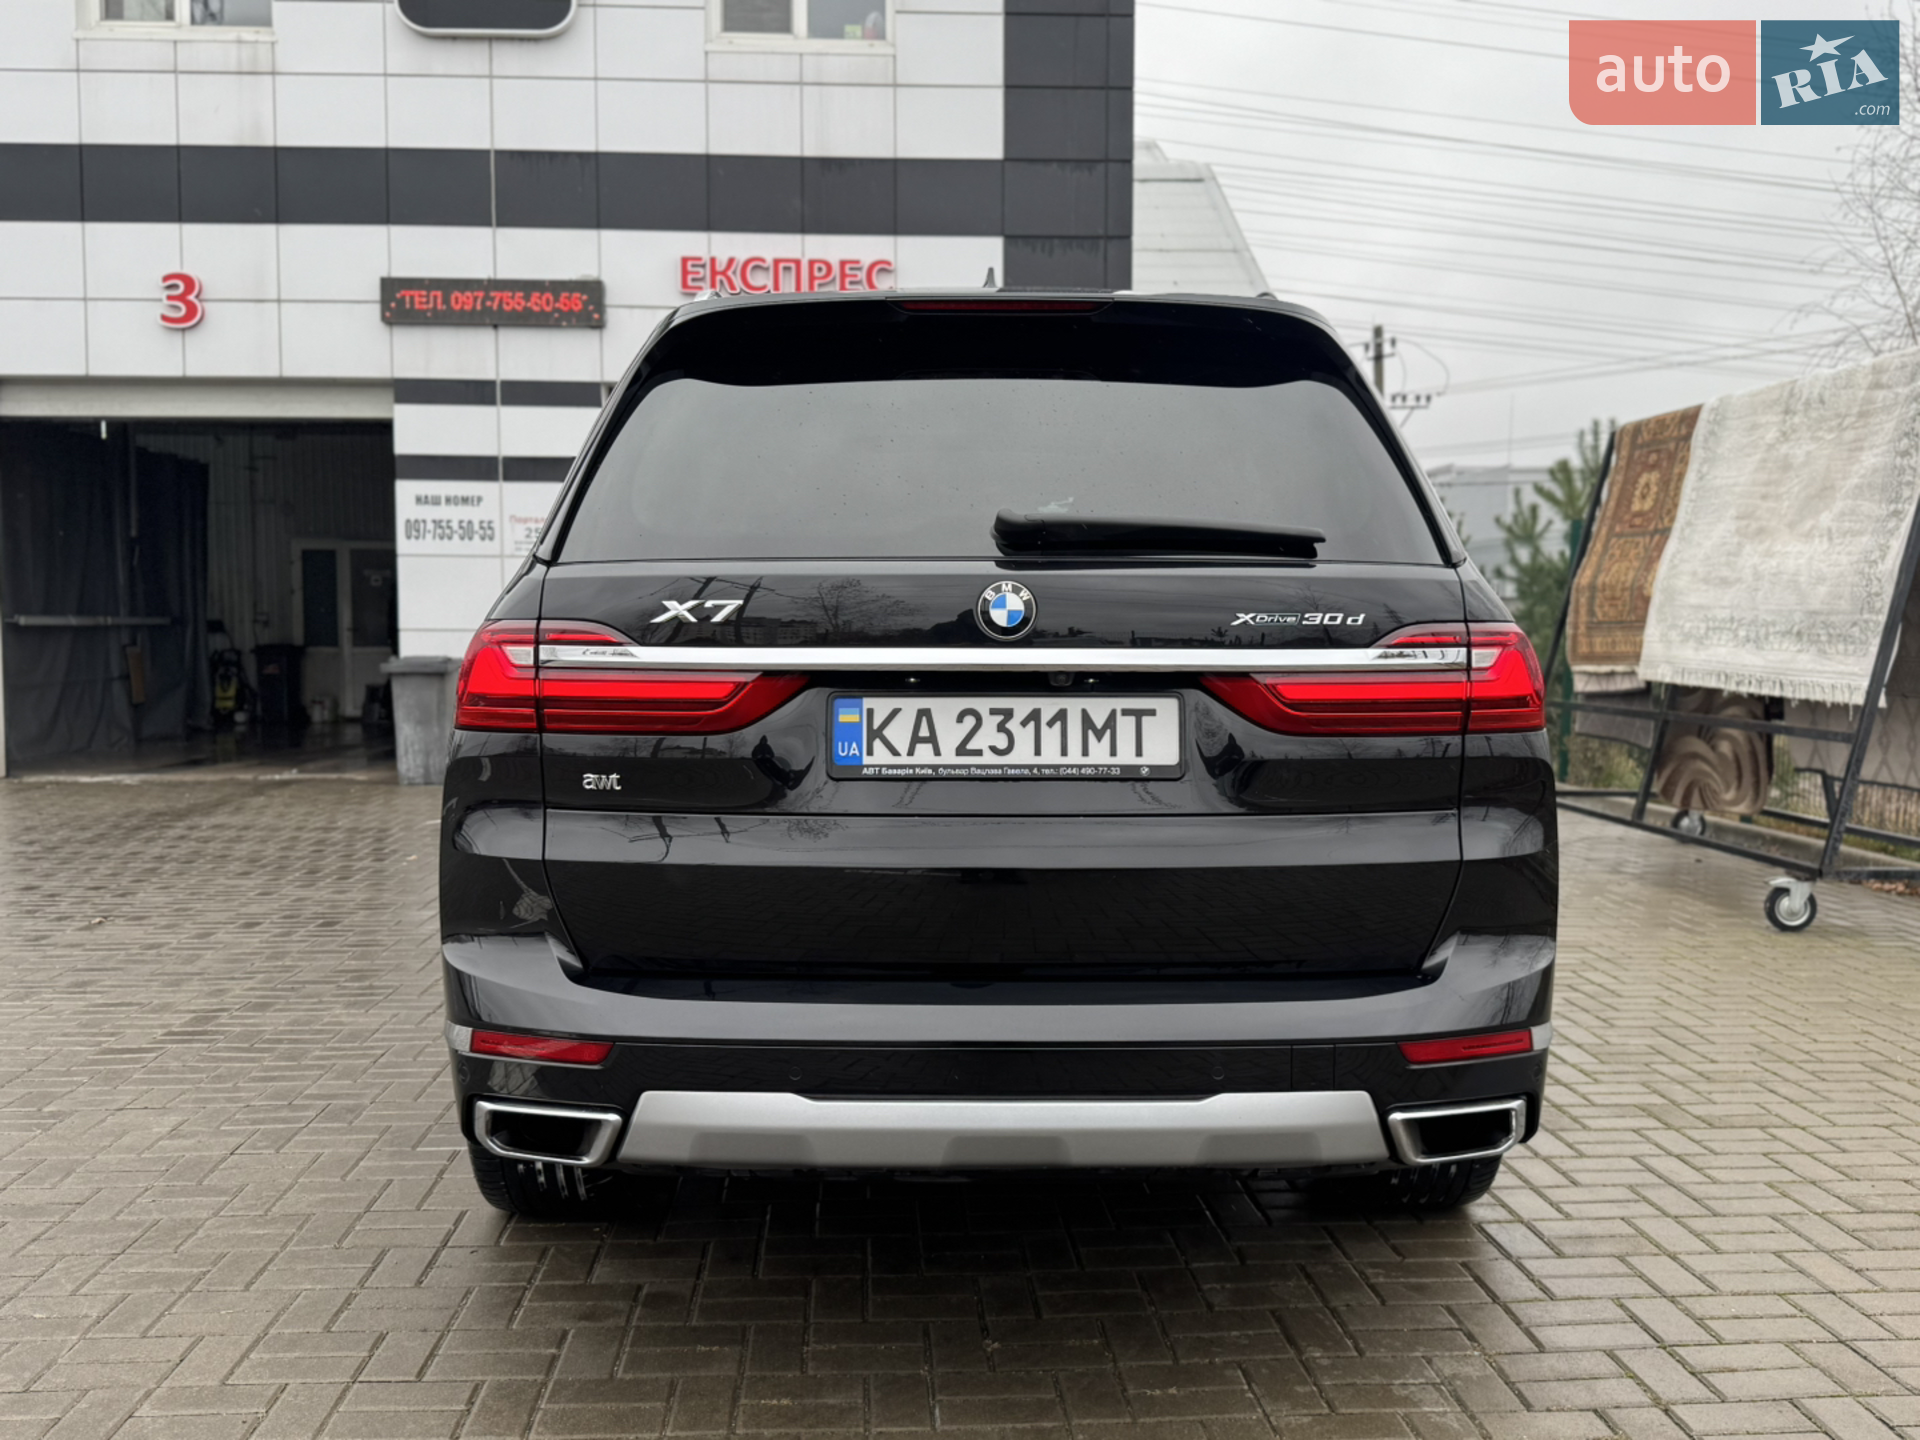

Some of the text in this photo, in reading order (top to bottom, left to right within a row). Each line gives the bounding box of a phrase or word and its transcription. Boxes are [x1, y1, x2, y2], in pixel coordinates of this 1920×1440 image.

[680, 255, 894, 294] ЕКСПРЕС
[159, 271, 205, 329] 3
[415, 494, 484, 507] НАШ НОМЕР
[404, 518, 495, 541] 097-755-50-55
[984, 582, 1031, 601] BMW
[649, 600, 744, 623] X7
[955, 707, 1069, 757] 2311
[838, 741, 861, 757] UA
[1059, 766, 1080, 776] (044)
